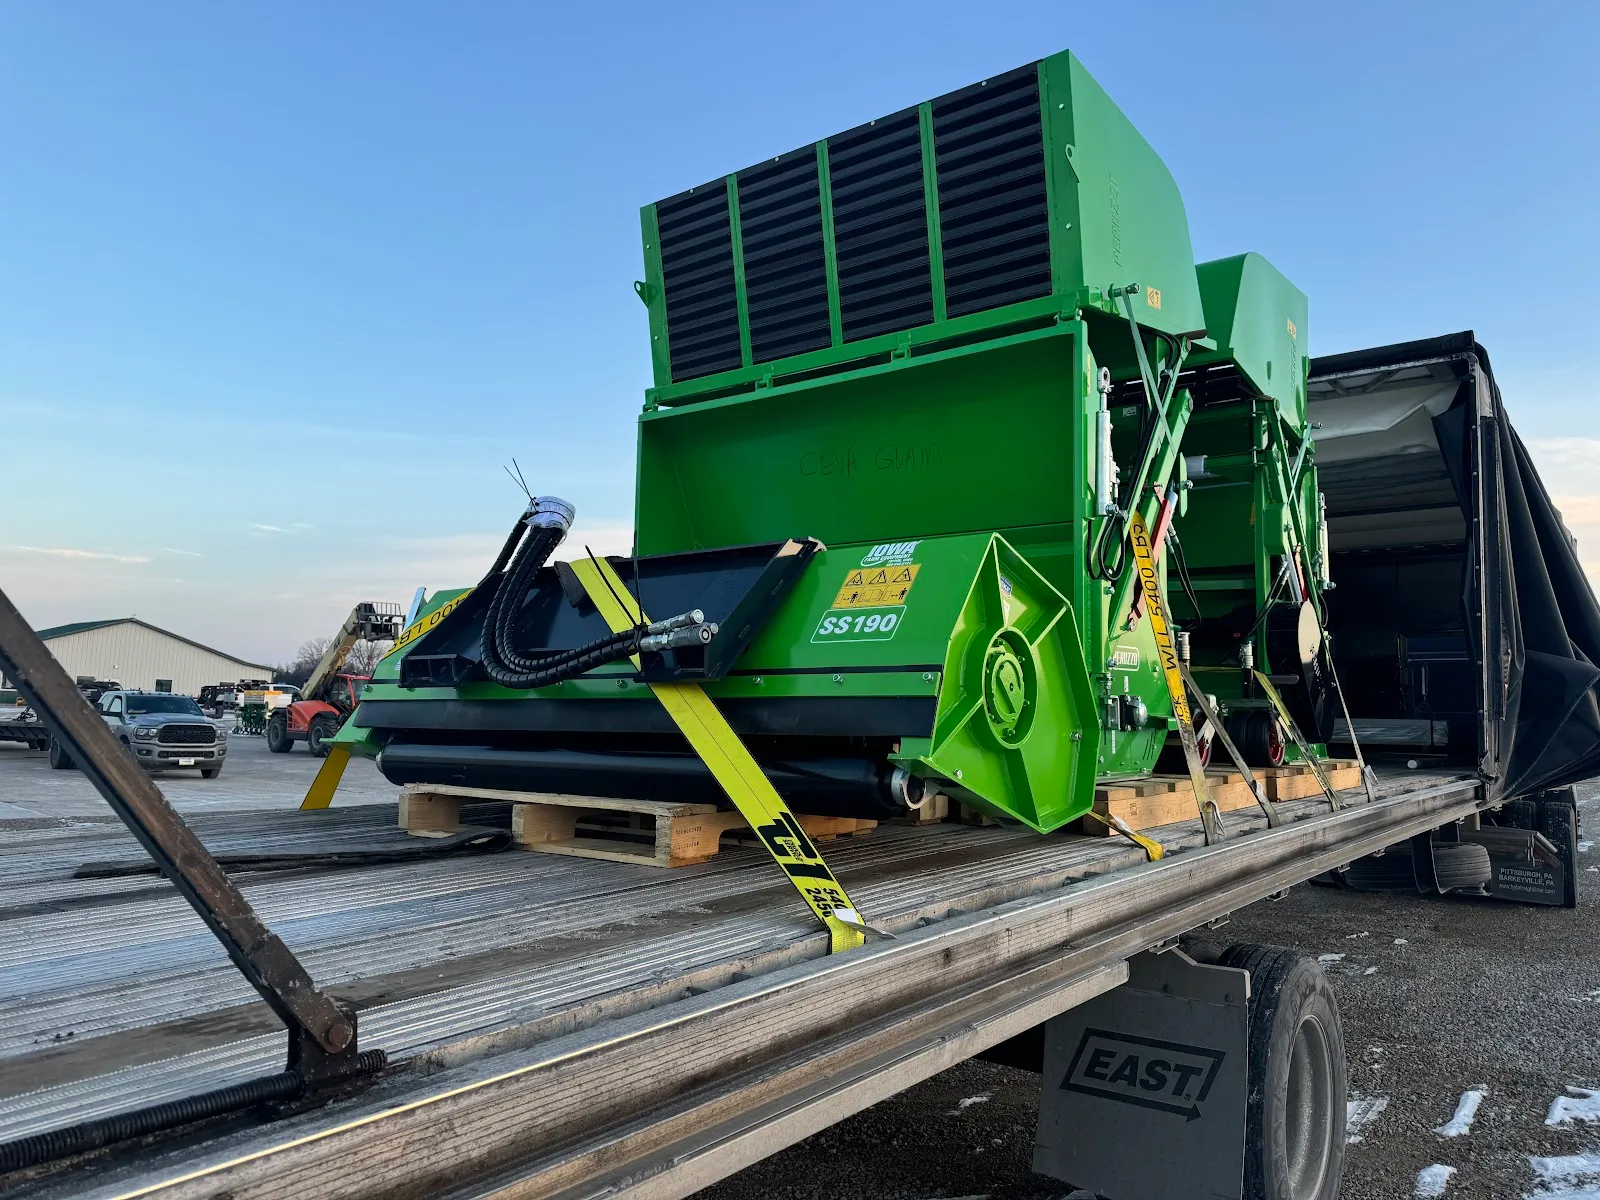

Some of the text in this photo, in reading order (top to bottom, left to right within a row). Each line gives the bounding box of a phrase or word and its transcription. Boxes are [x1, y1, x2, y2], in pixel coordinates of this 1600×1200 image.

[867, 541, 917, 558] IOWA
[1141, 567, 1163, 619] 5400
[818, 613, 897, 635] SS190
[1157, 629, 1177, 671] WLL
[1498, 874, 1545, 886] BARKEYVILLE,
[1500, 867, 1543, 879] PITTSBURGH,
[1083, 1047, 1204, 1097] EAST
